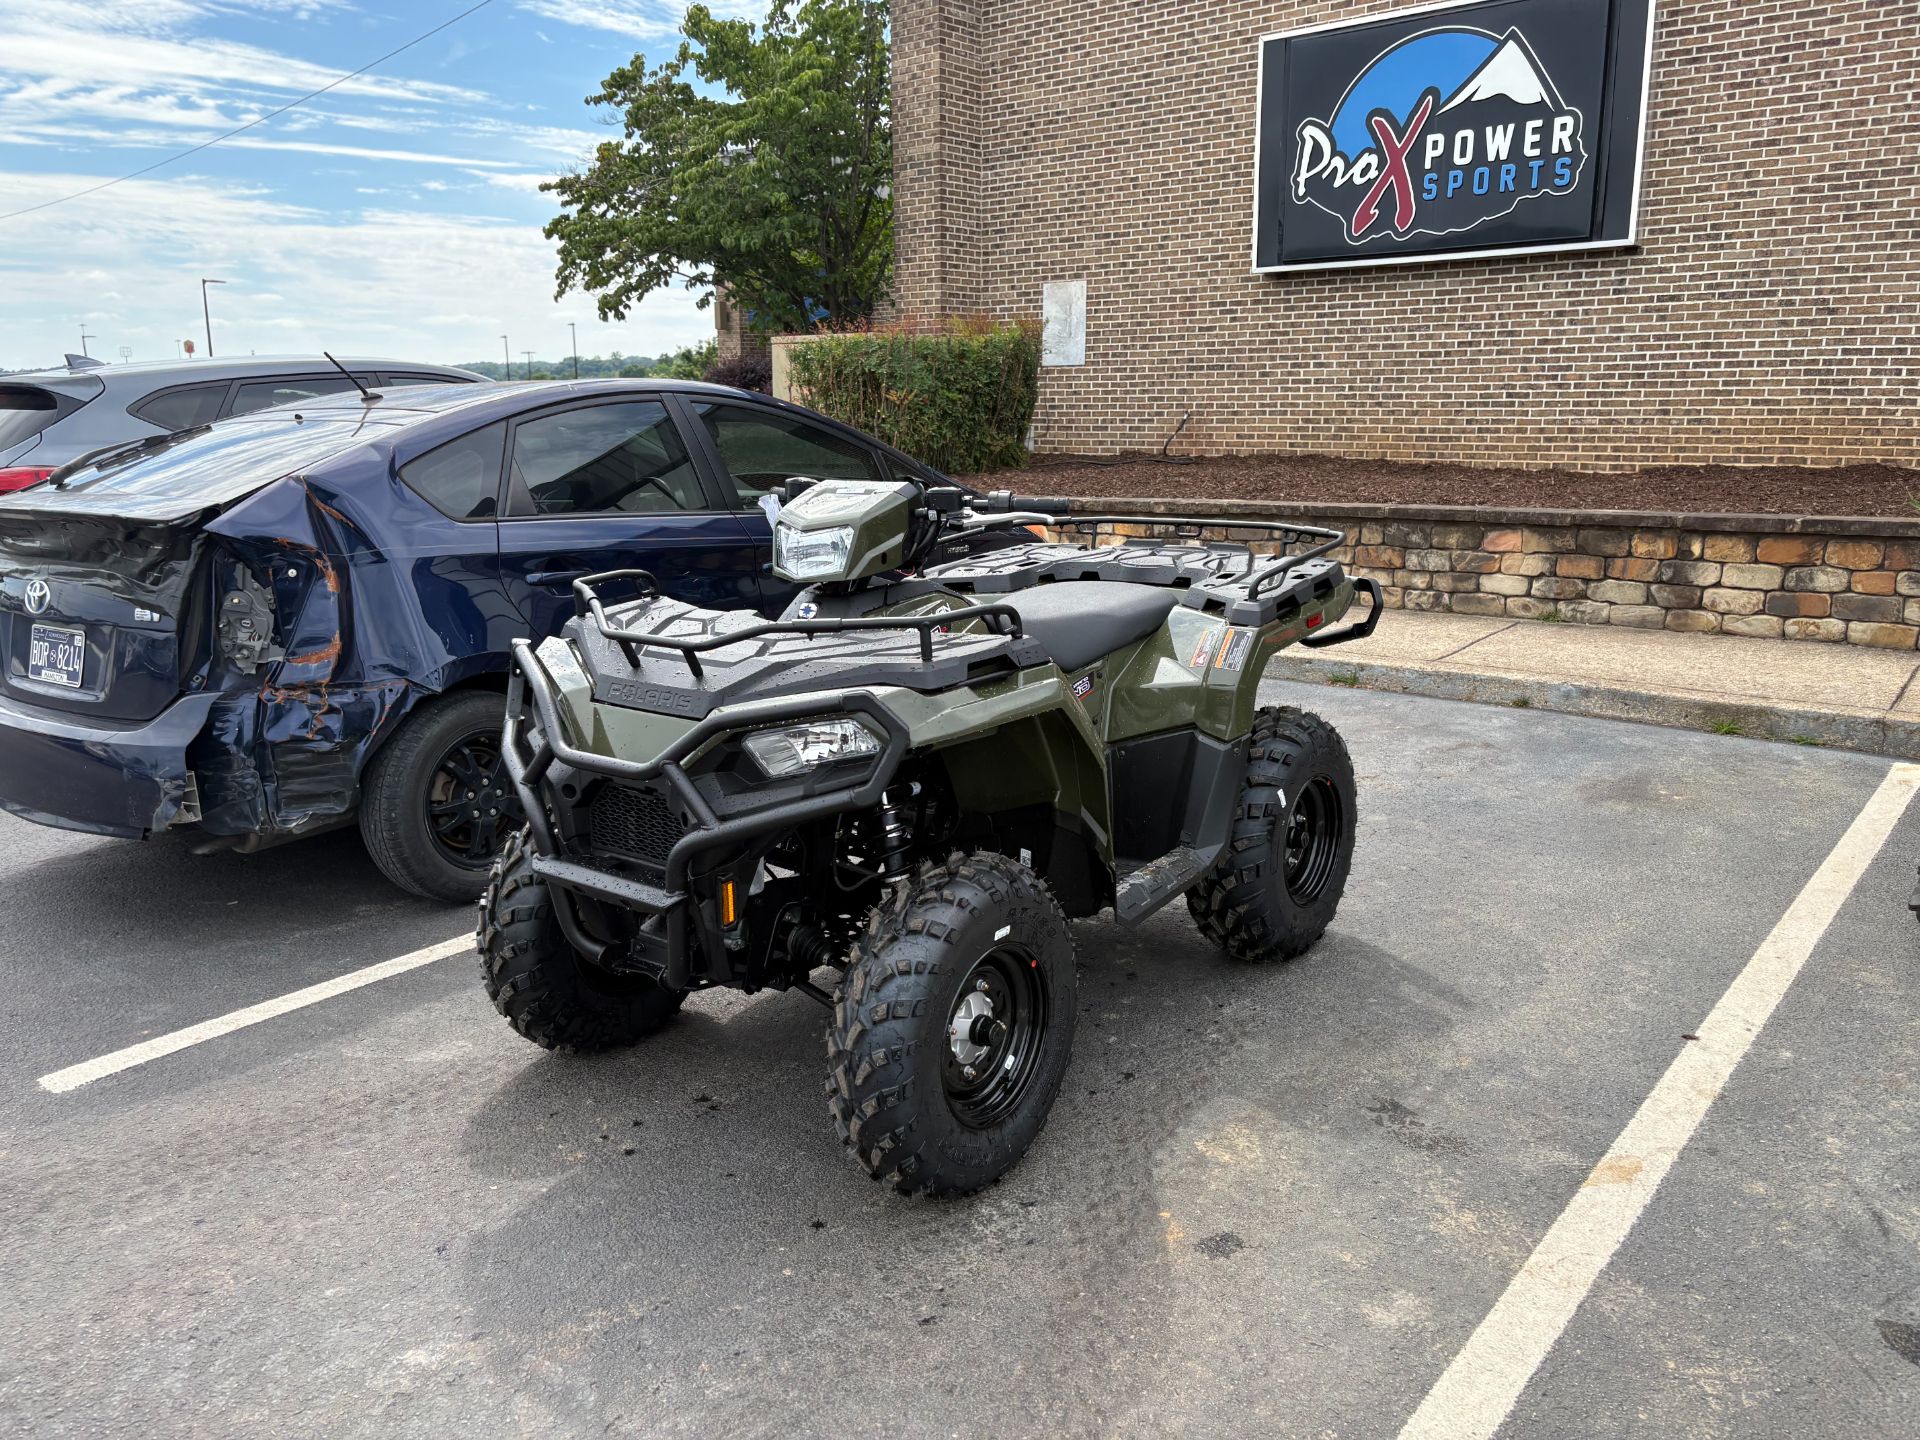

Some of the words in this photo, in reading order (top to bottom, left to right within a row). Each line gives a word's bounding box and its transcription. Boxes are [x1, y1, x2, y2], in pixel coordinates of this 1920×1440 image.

[1424, 115, 1575, 170] POWER
[1422, 157, 1573, 201] SPORTS
[57, 643, 80, 673] 8214
[607, 681, 693, 711] POLARIS
